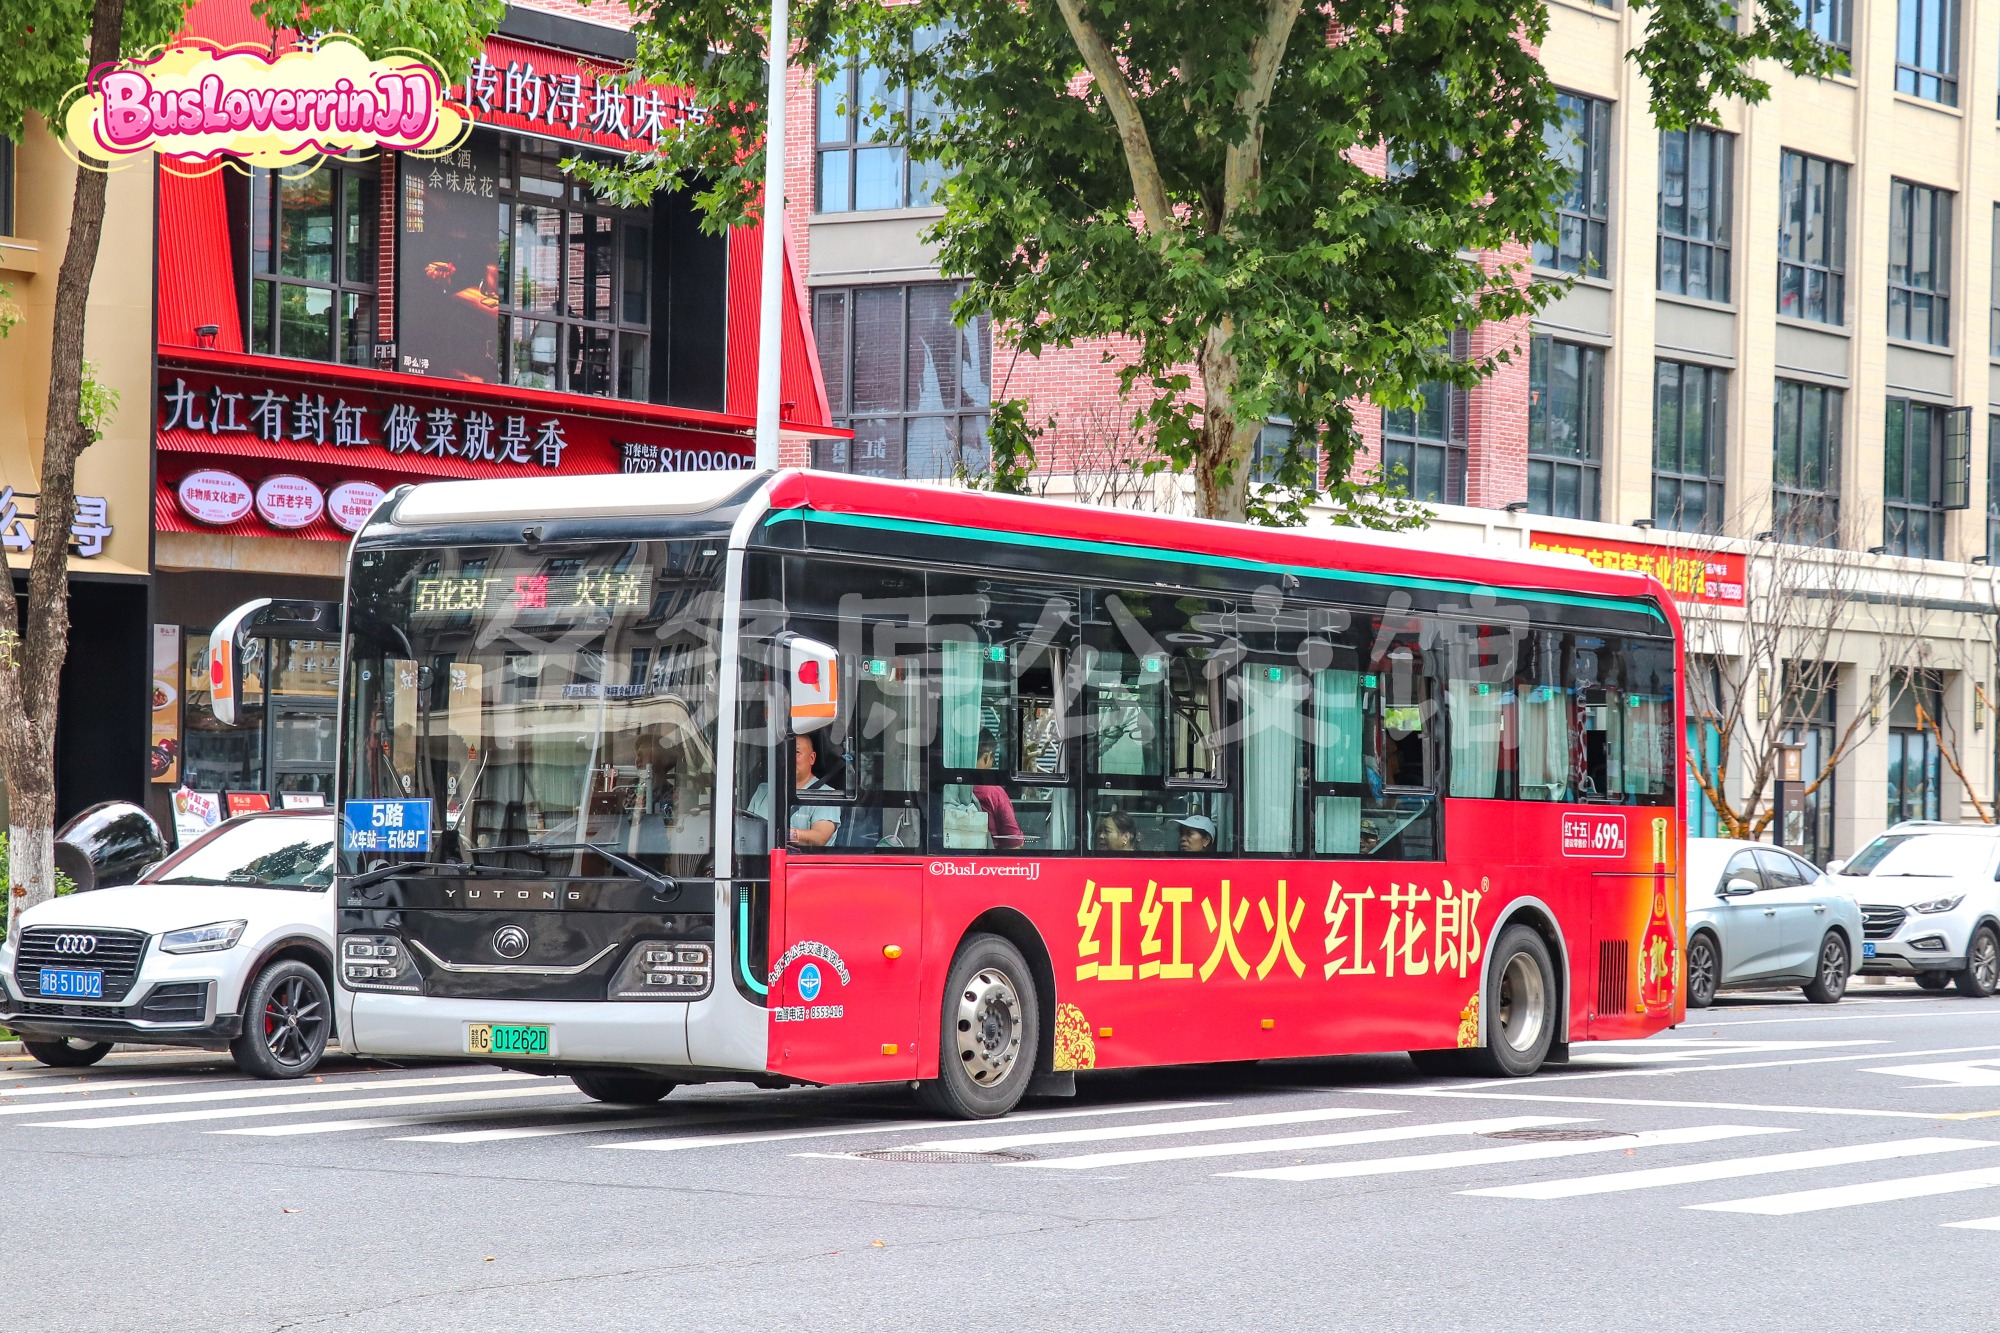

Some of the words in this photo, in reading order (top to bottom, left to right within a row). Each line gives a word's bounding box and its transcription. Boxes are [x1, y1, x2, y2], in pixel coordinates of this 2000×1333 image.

[428, 166, 494, 199] 余味成花
[164, 378, 370, 446] 九江有封缸
[384, 403, 568, 468] 做菜就是香
[624, 443, 658, 459] 订餐电话
[267, 493, 313, 510] 江西老字号
[416, 578, 503, 611] 石化总厂
[513, 575, 549, 609] 5路
[572, 573, 641, 608] 火车站
[371, 803, 404, 828] 5路
[348, 829, 377, 849] 火车站
[387, 830, 426, 849] 石化总厂
[1564, 821, 1588, 838] 红十五
[445, 889, 581, 900] YUTONG
[1075, 878, 1307, 984] 红红火火
[768, 940, 851, 988] 九江市公共交通集团公司
